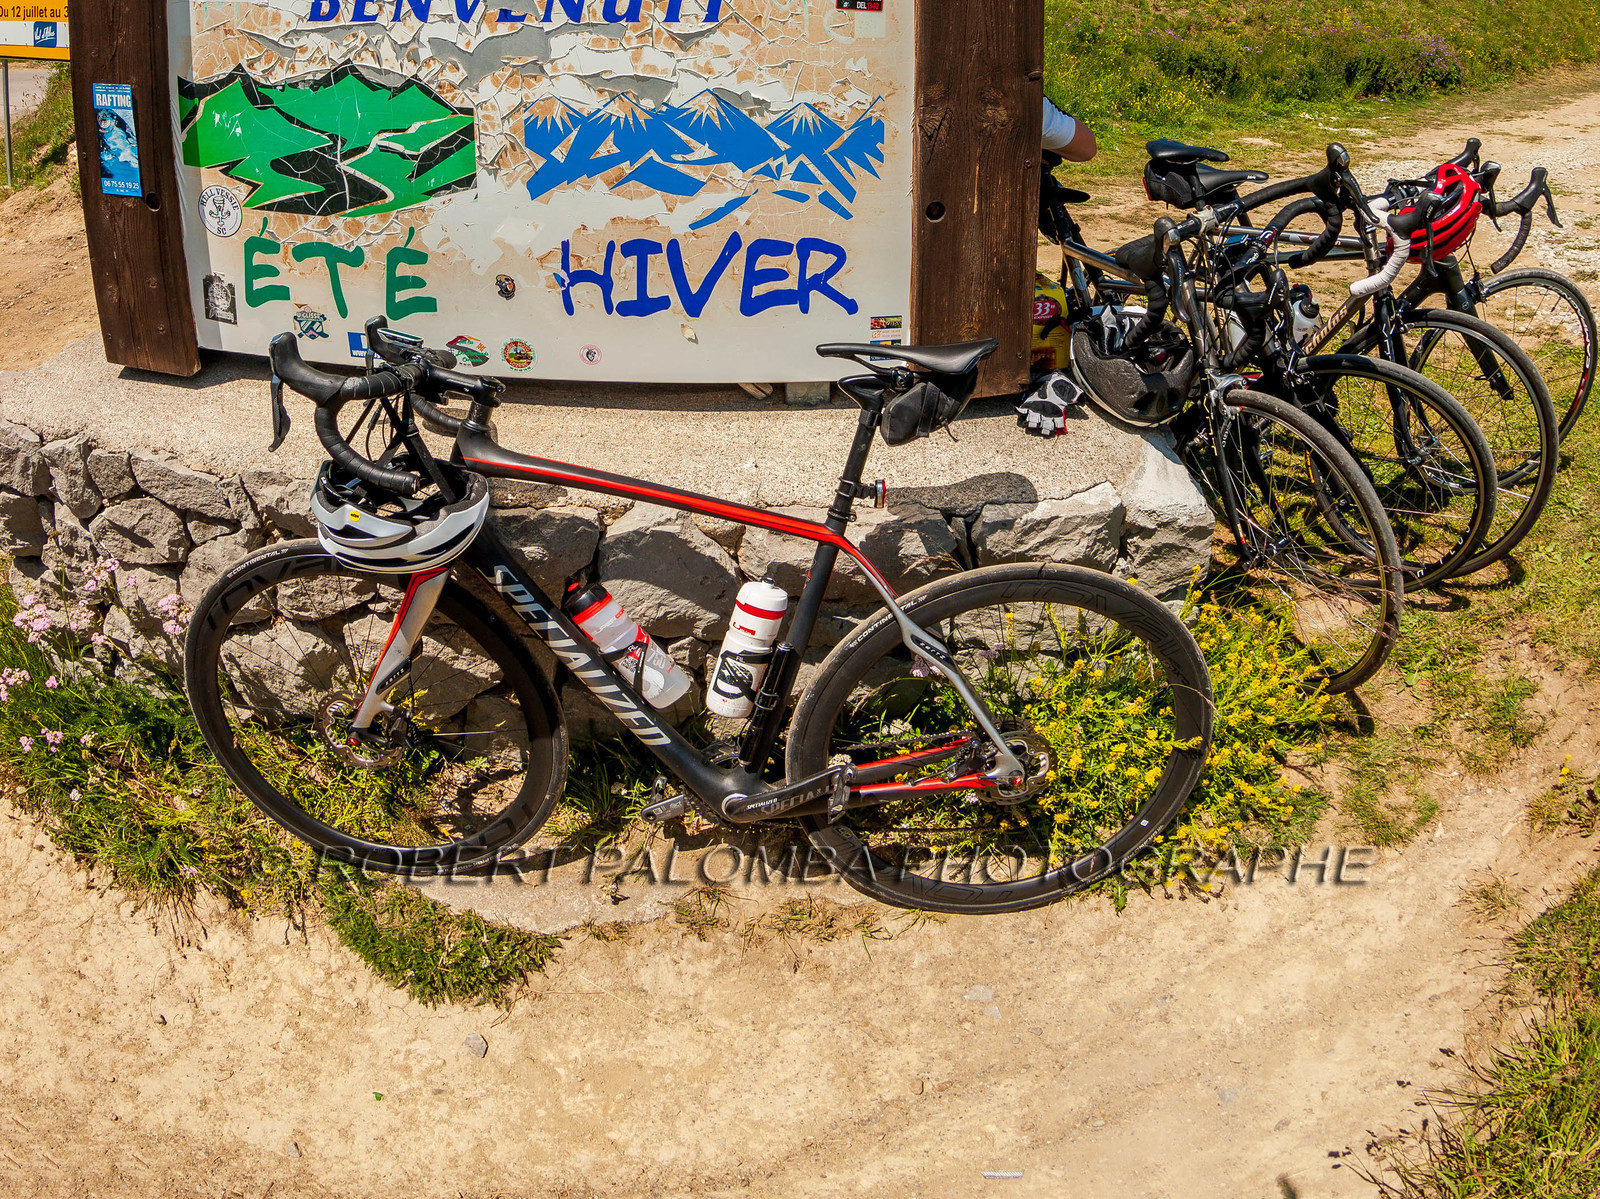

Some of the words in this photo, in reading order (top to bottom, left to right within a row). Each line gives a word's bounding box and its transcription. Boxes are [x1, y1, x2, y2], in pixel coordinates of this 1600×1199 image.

[0, 6, 9, 18] Du
[11, 6, 21, 18] 12
[23, 5, 48, 21] juillet
[49, 7, 61, 18] au
[95, 93, 132, 108] RAFTING
[200, 187, 214, 206] HELL
[215, 187, 240, 211] VESSIE
[216, 226, 227, 236] SC
[244, 216, 438, 321] ÉTÉ
[558, 230, 859, 319] HIVER
[231, 550, 281, 576] CONTINENTAL
[477, 563, 672, 746] SPECIALIZED
